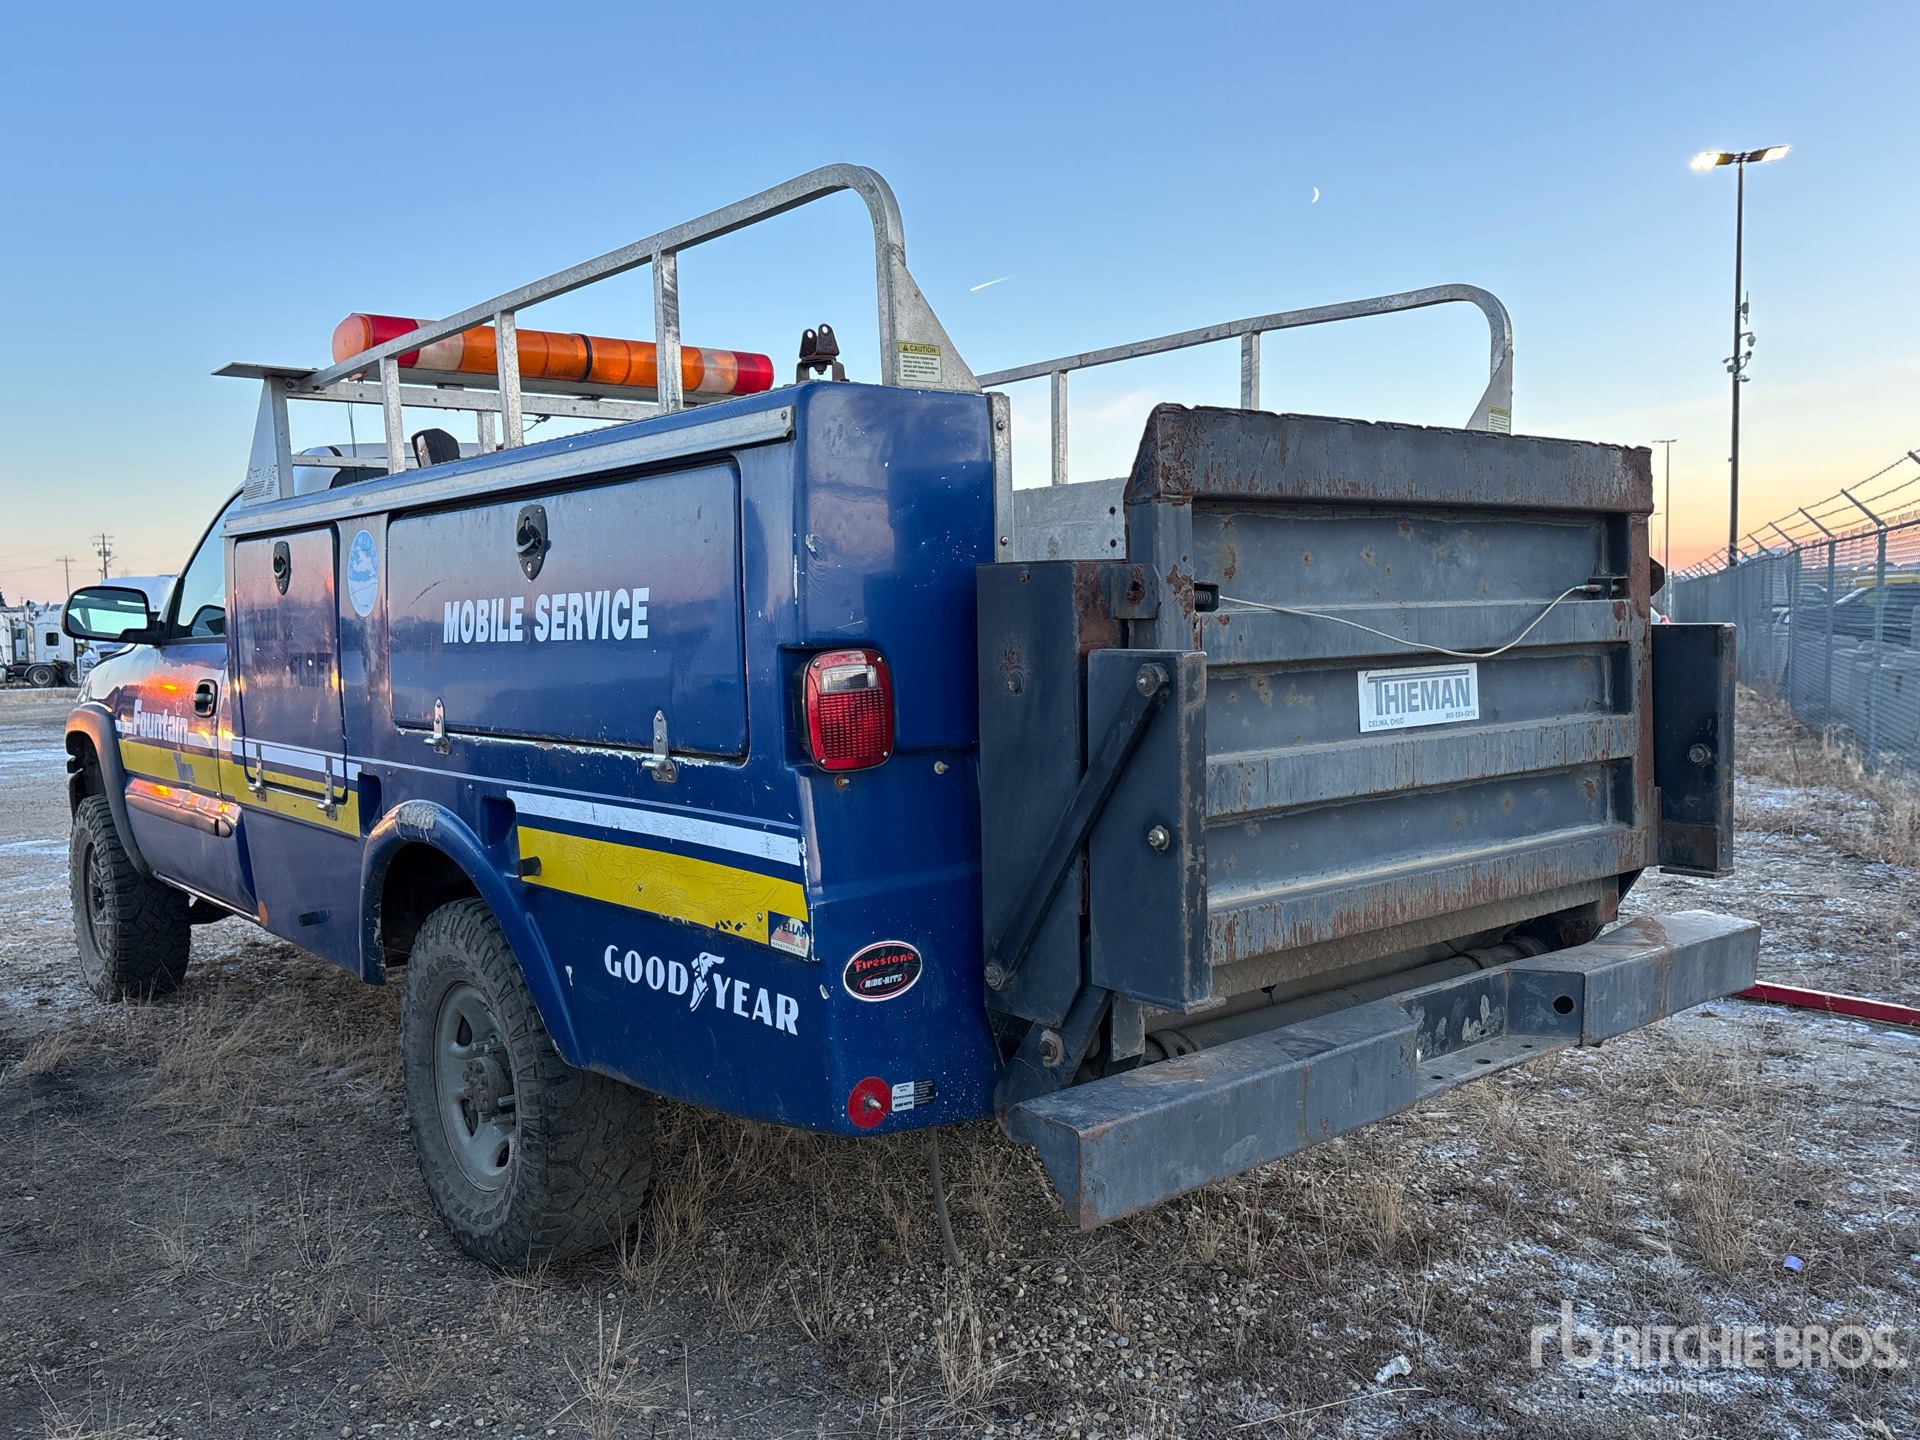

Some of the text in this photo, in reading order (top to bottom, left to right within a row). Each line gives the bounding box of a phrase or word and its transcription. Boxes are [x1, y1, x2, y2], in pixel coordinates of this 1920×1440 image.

[909, 344, 936, 354] CAUTION
[443, 587, 650, 644] MOBILE SERVICE
[1367, 669, 1471, 716] THIEMAN
[133, 698, 189, 745] Fountain
[1368, 717, 1405, 728] CELINA, OHIO
[853, 952, 915, 973] Firestone
[864, 973, 903, 988] RIDE-RITE
